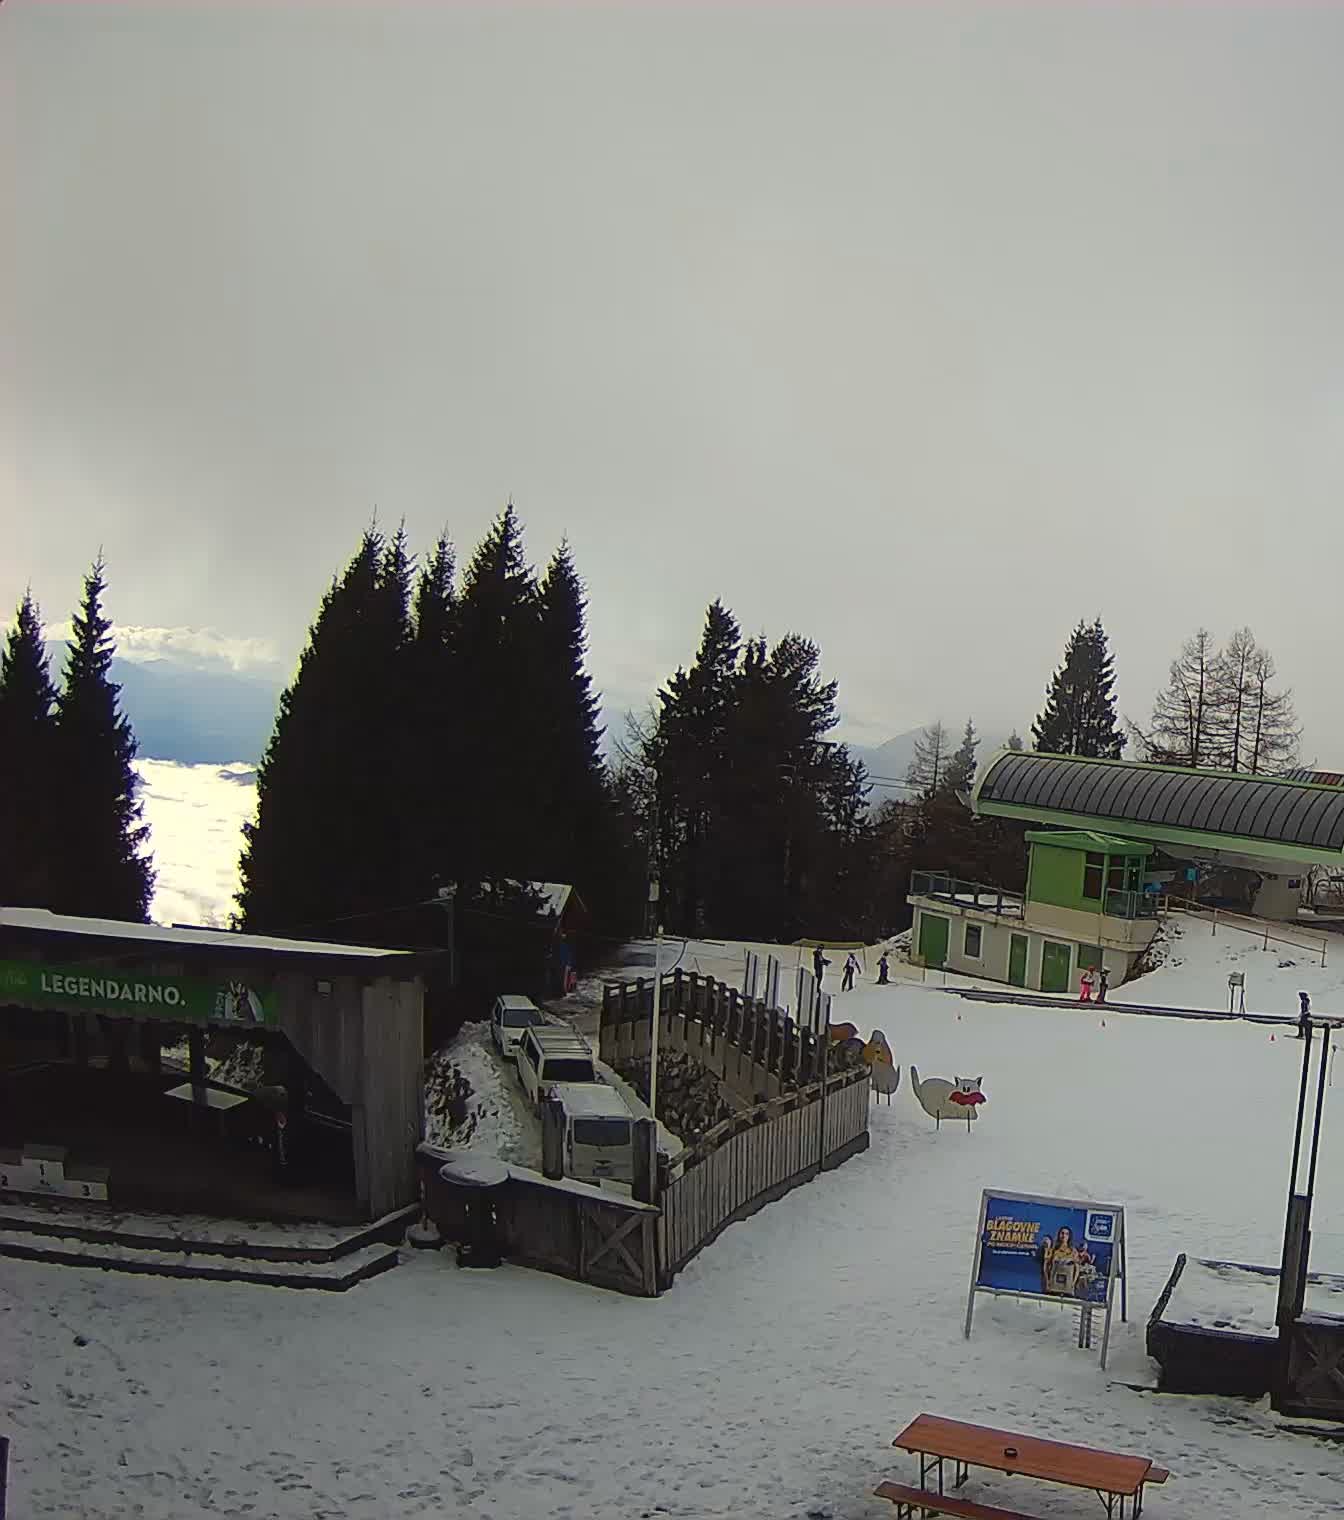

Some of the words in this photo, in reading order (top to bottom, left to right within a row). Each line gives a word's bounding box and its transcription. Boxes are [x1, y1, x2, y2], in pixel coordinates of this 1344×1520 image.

[40, 973, 187, 1006] LEGENDARNO.
[986, 1220, 1041, 1233] BLAGOVNE
[990, 1231, 1035, 1243] ZNAMKE
